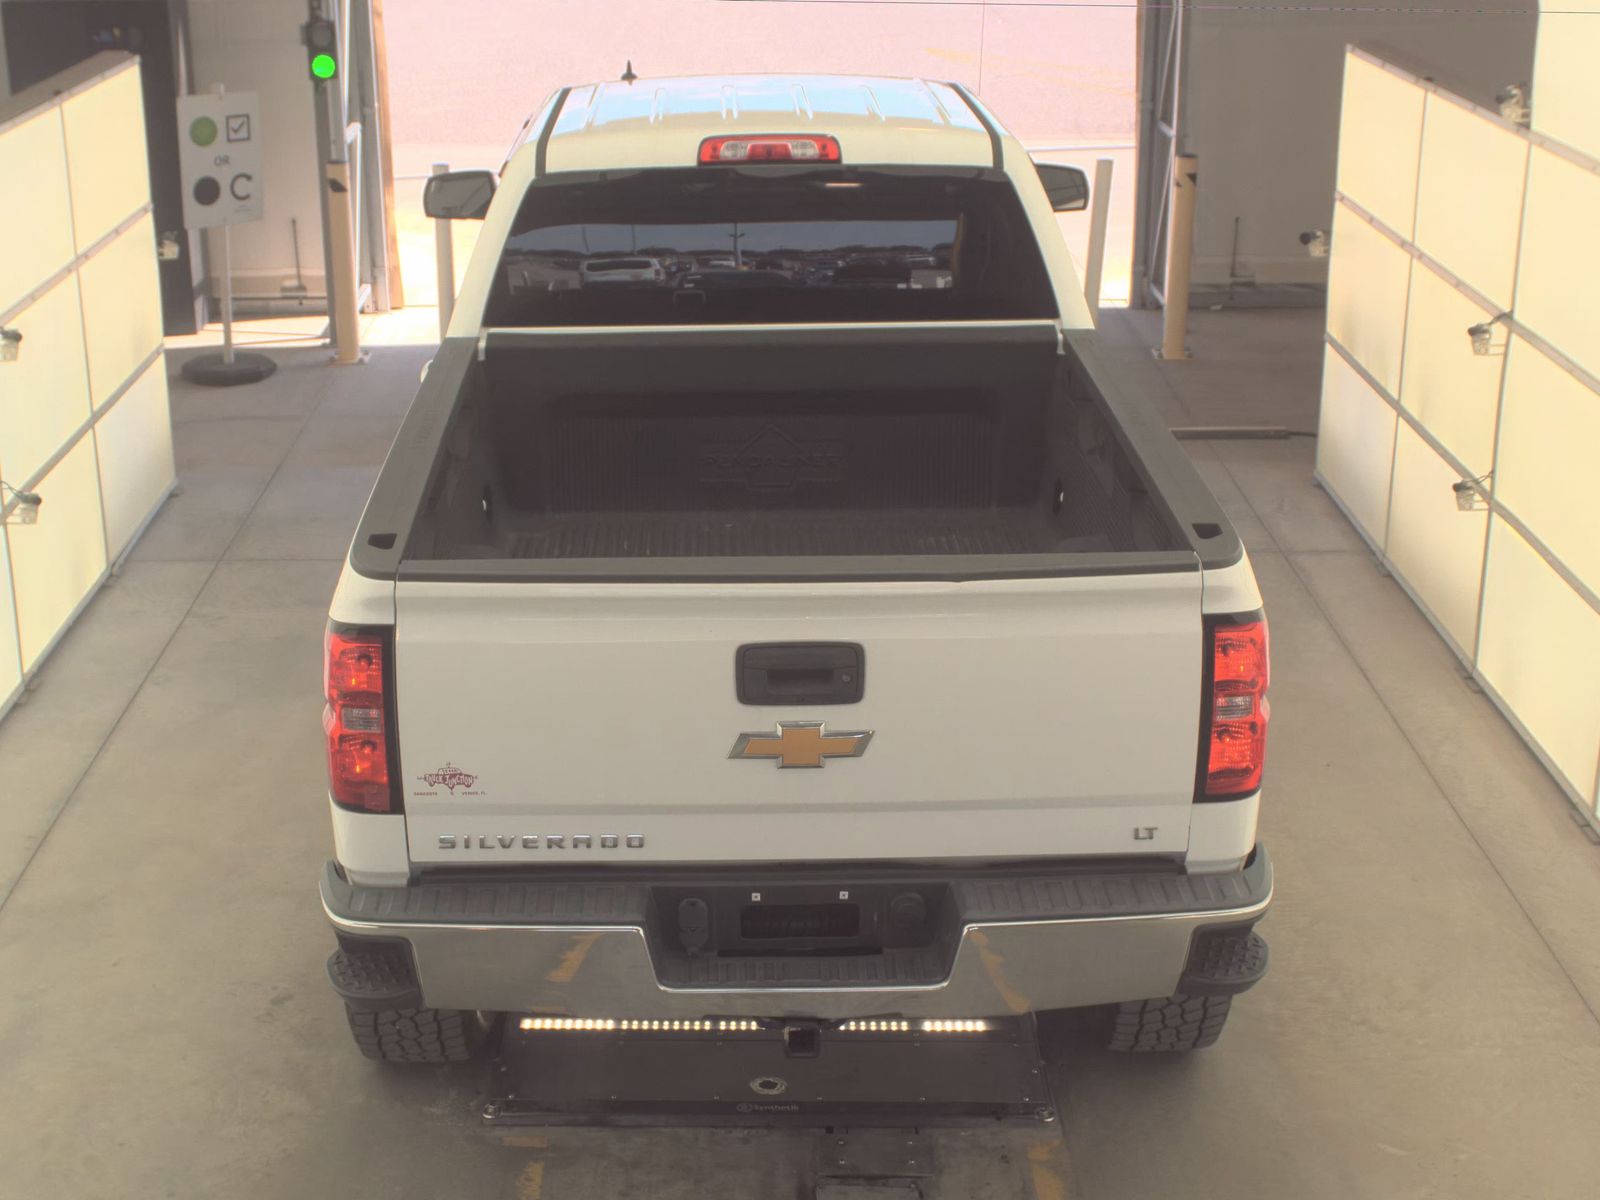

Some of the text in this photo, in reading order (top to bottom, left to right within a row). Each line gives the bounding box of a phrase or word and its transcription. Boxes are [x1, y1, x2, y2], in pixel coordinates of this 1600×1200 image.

[214, 155, 231, 167] OR
[230, 172, 253, 201] C
[1133, 826, 1159, 841] LT
[438, 834, 645, 849] SILVERADO
